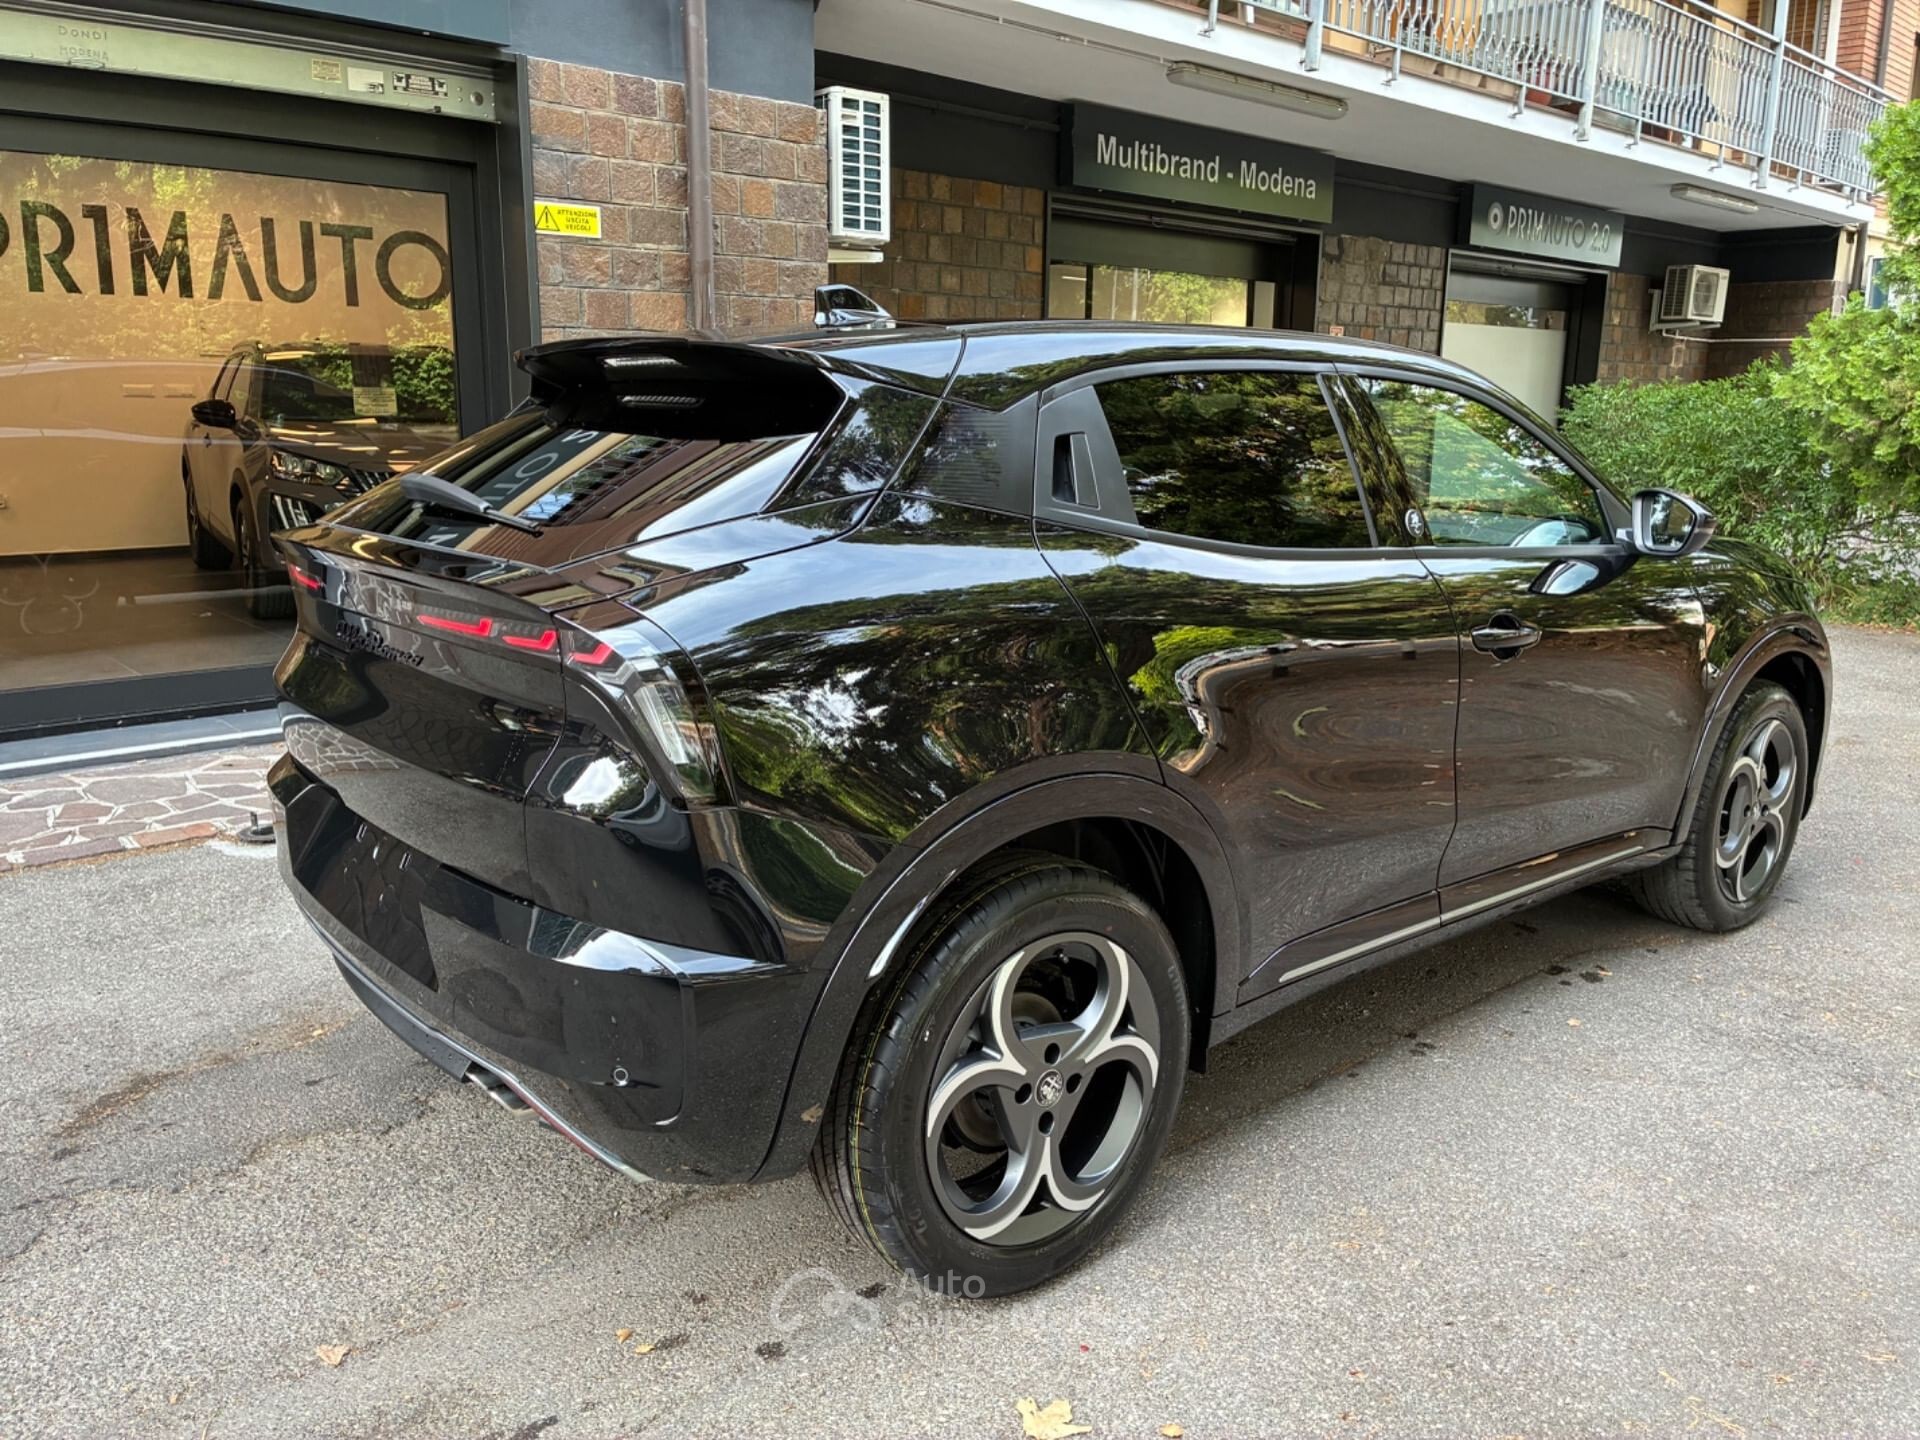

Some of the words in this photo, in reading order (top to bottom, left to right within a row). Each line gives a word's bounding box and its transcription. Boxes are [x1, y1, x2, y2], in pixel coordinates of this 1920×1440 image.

[1096, 133, 1220, 183] Multibrand
[1240, 160, 1317, 199] Modena
[556, 209, 598, 218] ATTENZIONE
